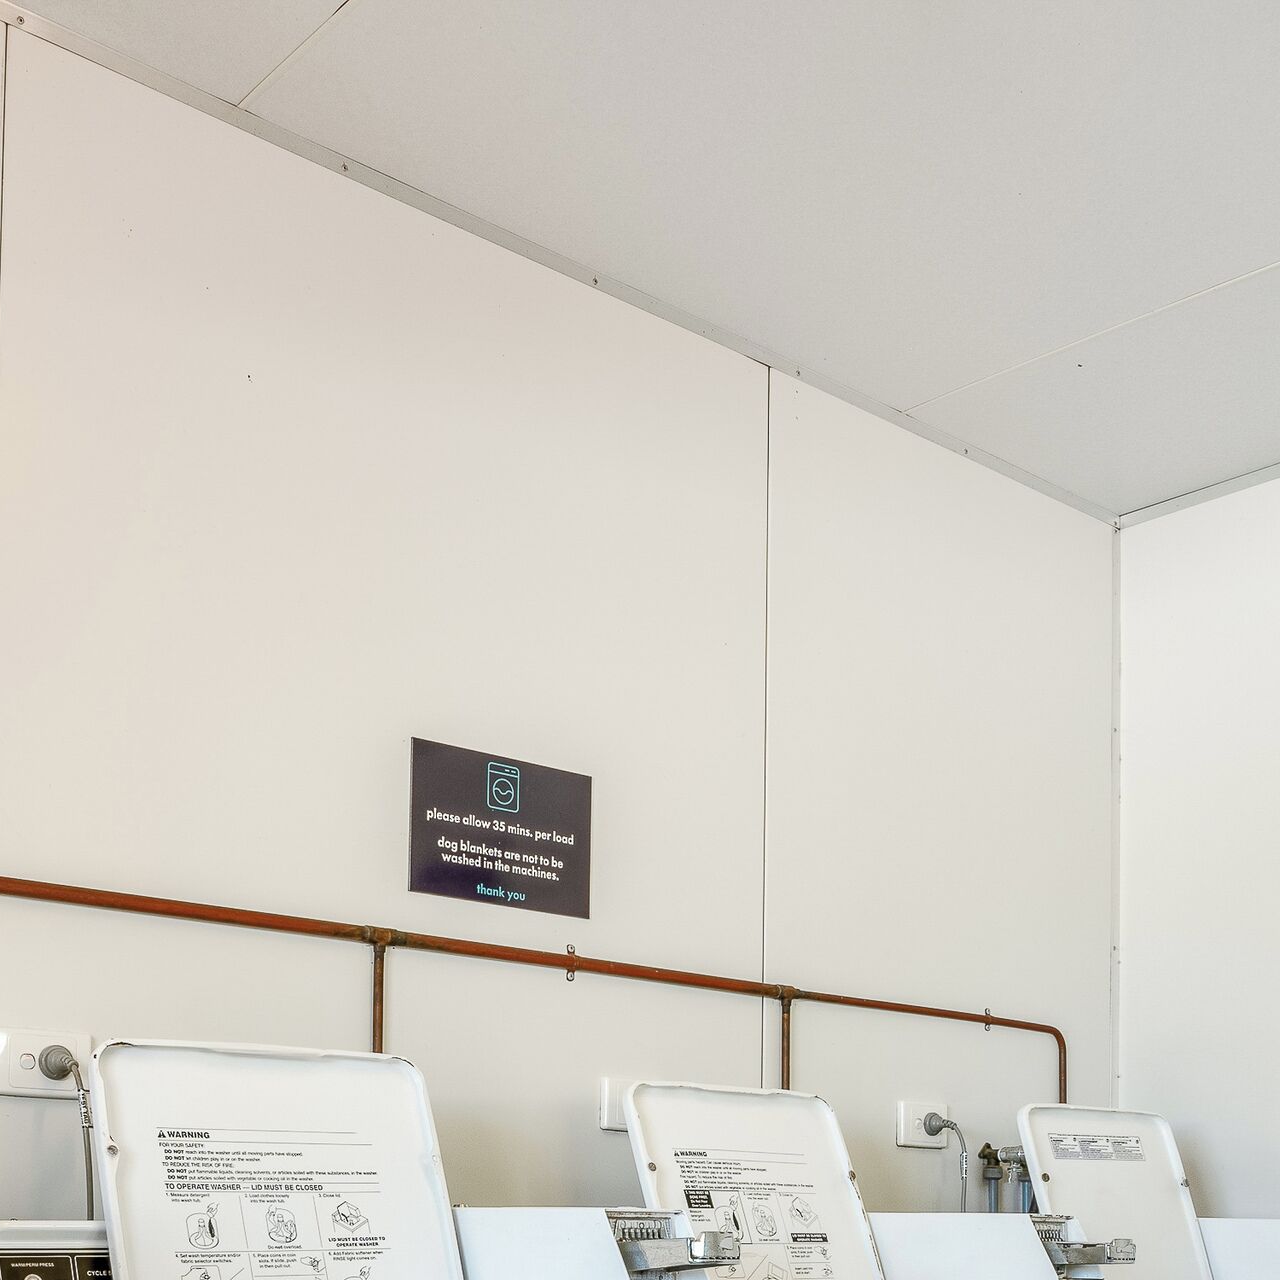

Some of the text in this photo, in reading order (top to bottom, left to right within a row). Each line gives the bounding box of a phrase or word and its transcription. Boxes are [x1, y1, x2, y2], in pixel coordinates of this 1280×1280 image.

[427, 808, 574, 845] please allow 35 mins. per load
[438, 837, 563, 869] dog blankets are not to be
[442, 853, 559, 881] washed in the machines.
[476, 883, 526, 901] thank you
[165, 1183, 175, 1191] TO
[176, 1183, 210, 1191] OPERATE
